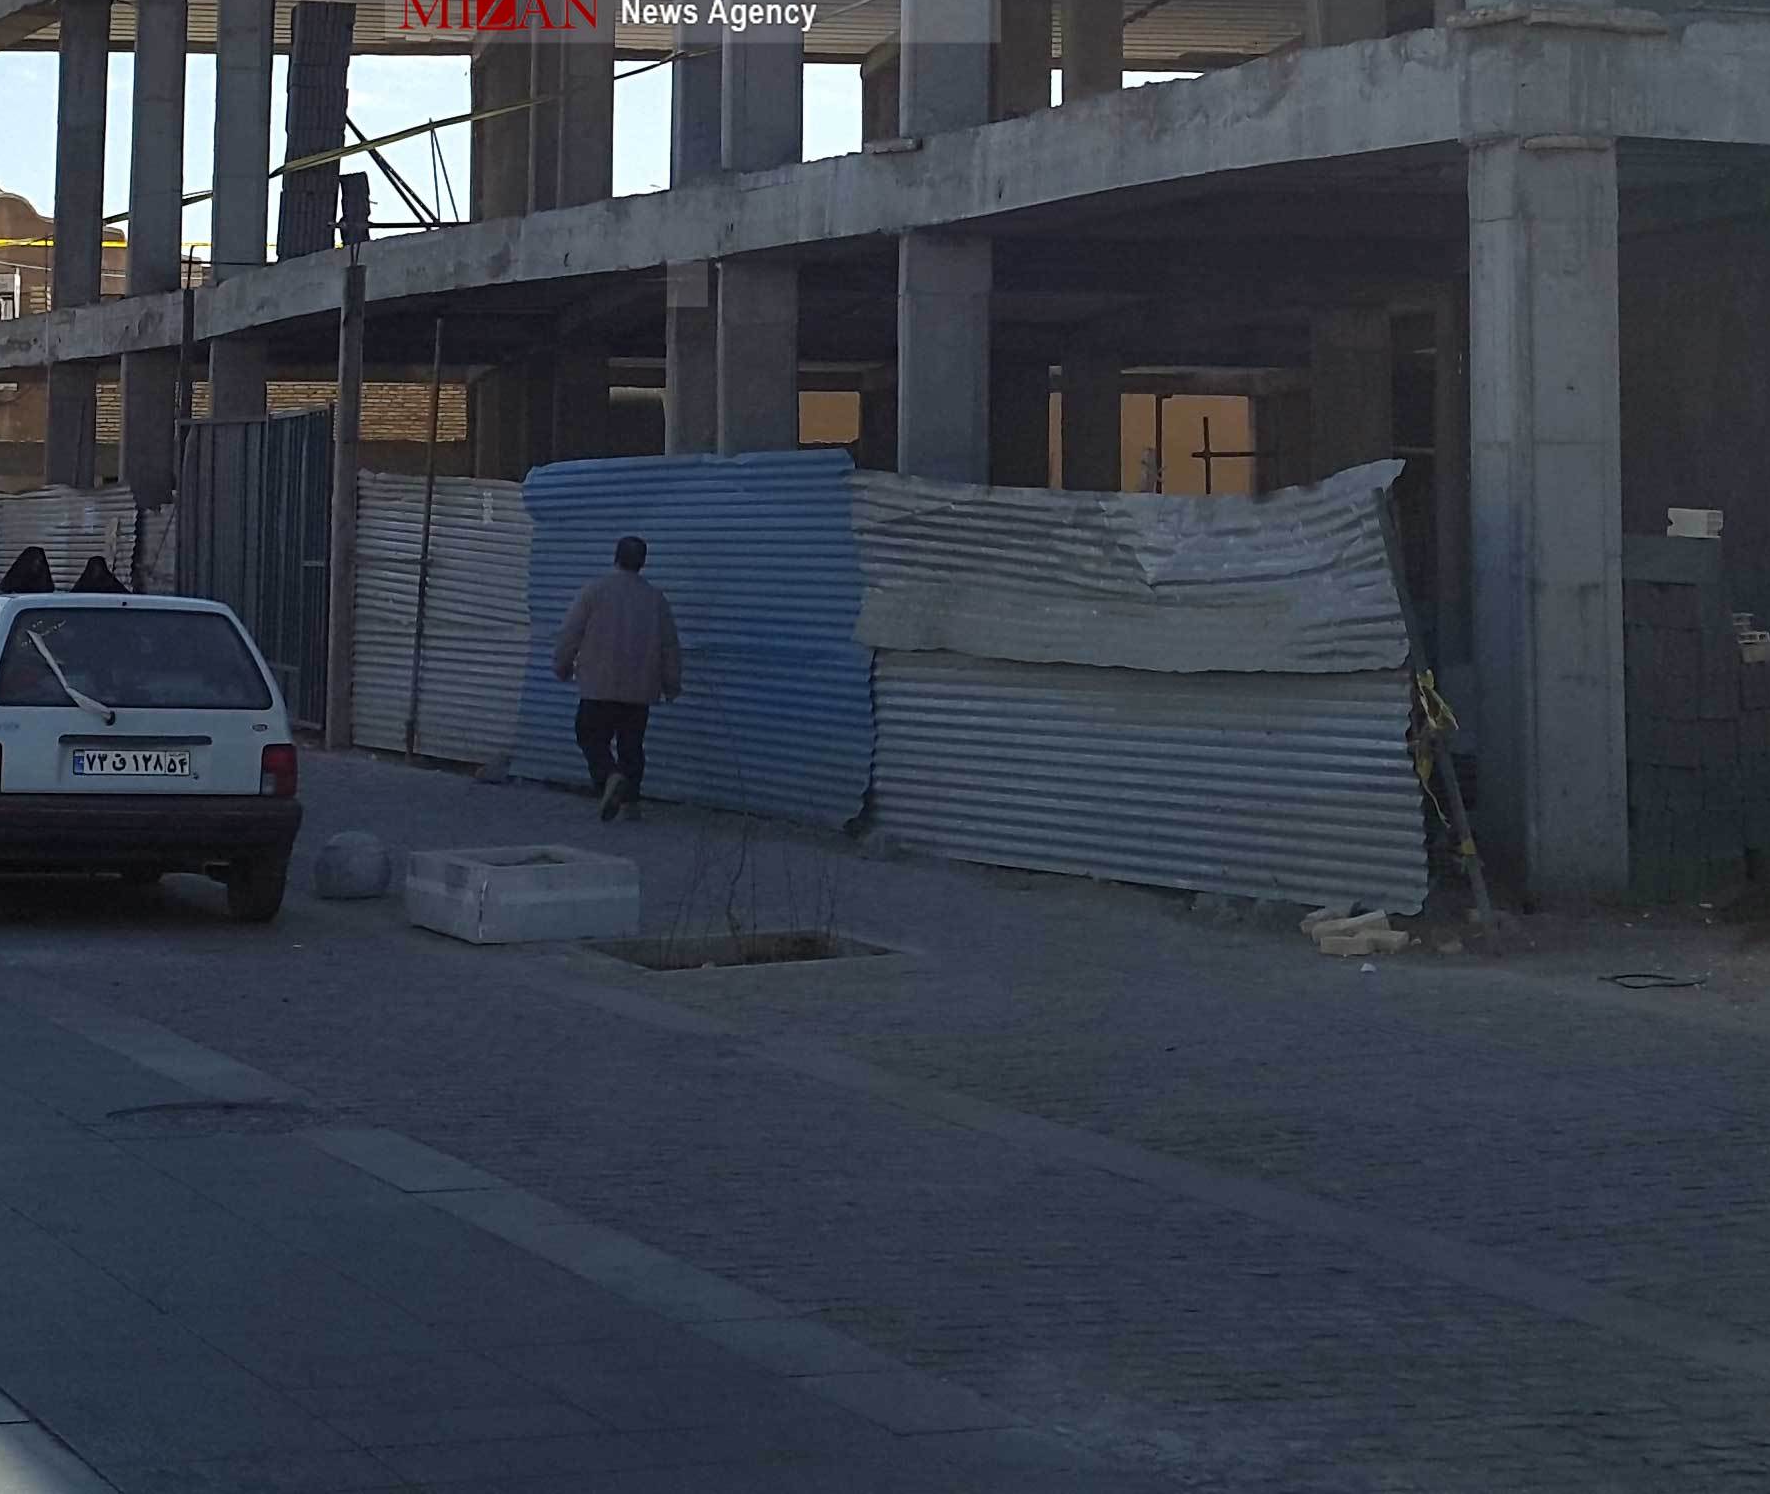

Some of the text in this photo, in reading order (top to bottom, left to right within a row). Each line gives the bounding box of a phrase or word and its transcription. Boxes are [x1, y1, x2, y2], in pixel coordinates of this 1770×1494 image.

[86, 753, 188, 774] ۷۳ ق ۱۲۸ ۵۴
